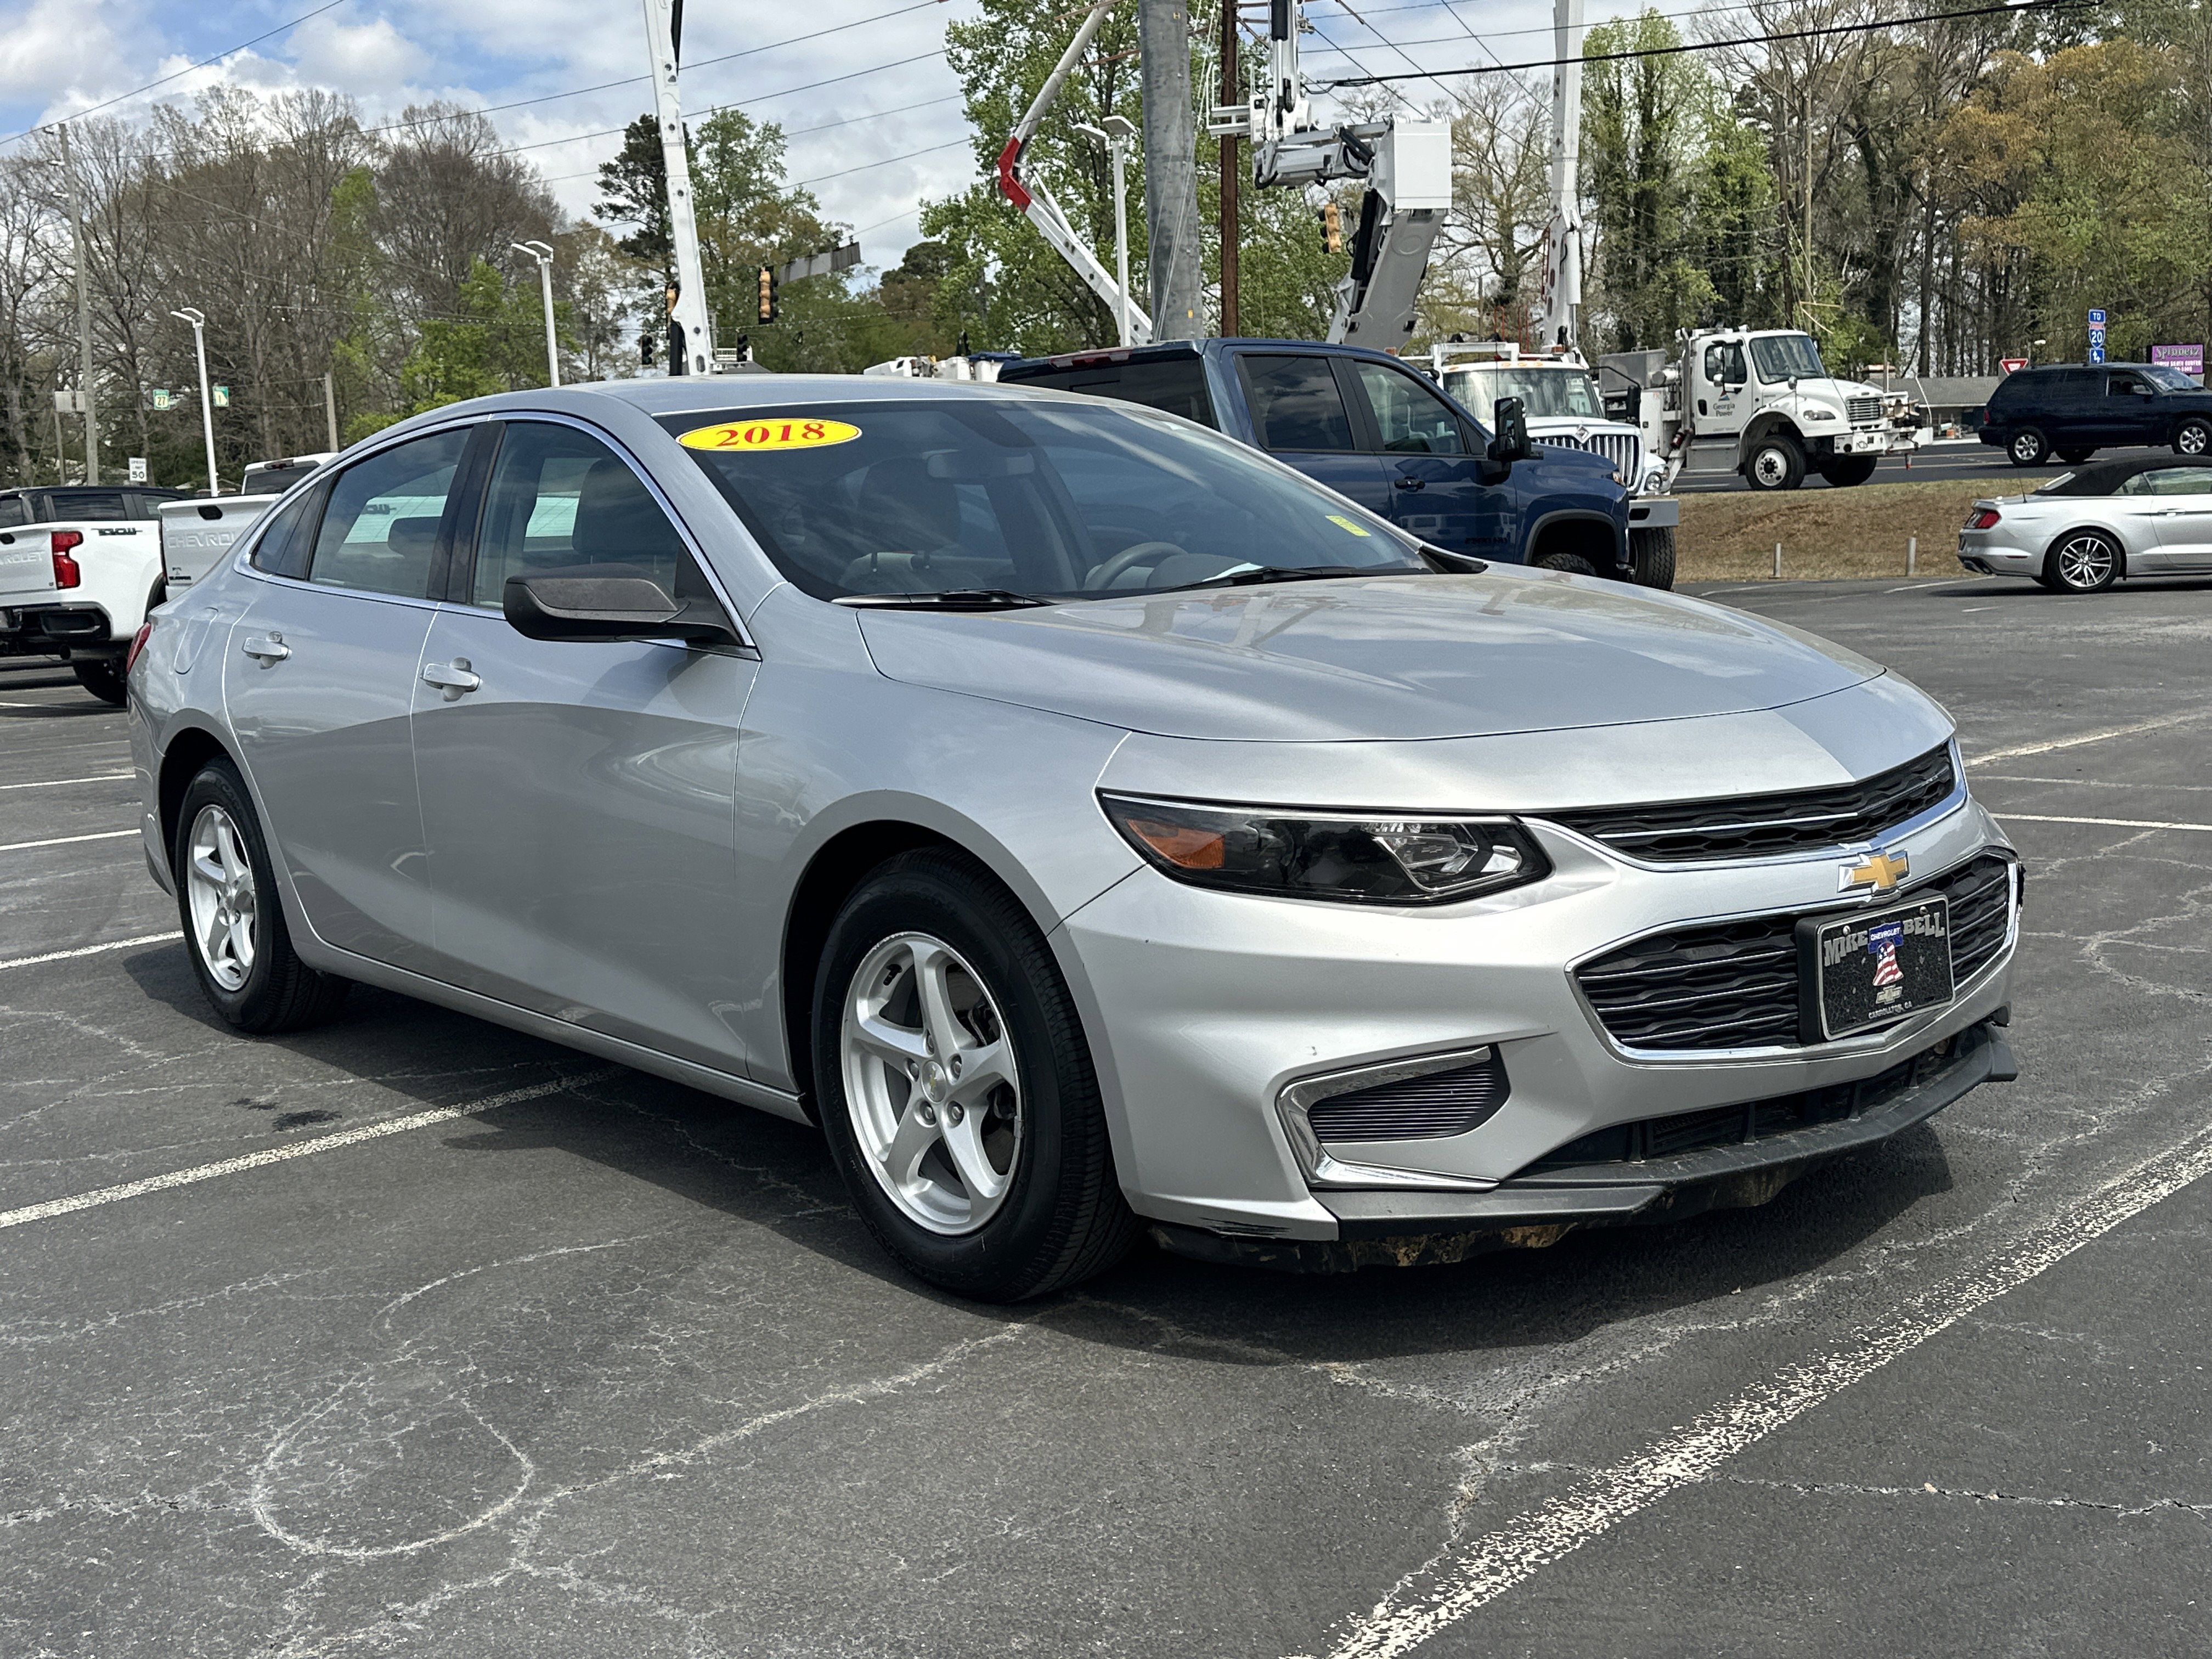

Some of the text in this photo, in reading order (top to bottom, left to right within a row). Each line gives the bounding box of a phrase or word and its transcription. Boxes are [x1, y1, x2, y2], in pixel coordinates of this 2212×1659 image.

[2091, 331, 2102, 343] 20
[157, 396, 166, 406] 27
[1713, 402, 1735, 410] Georgia
[716, 422, 825, 447] 2018
[132, 471, 145, 479] 50
[1824, 912, 1945, 967] MIKE BELL
